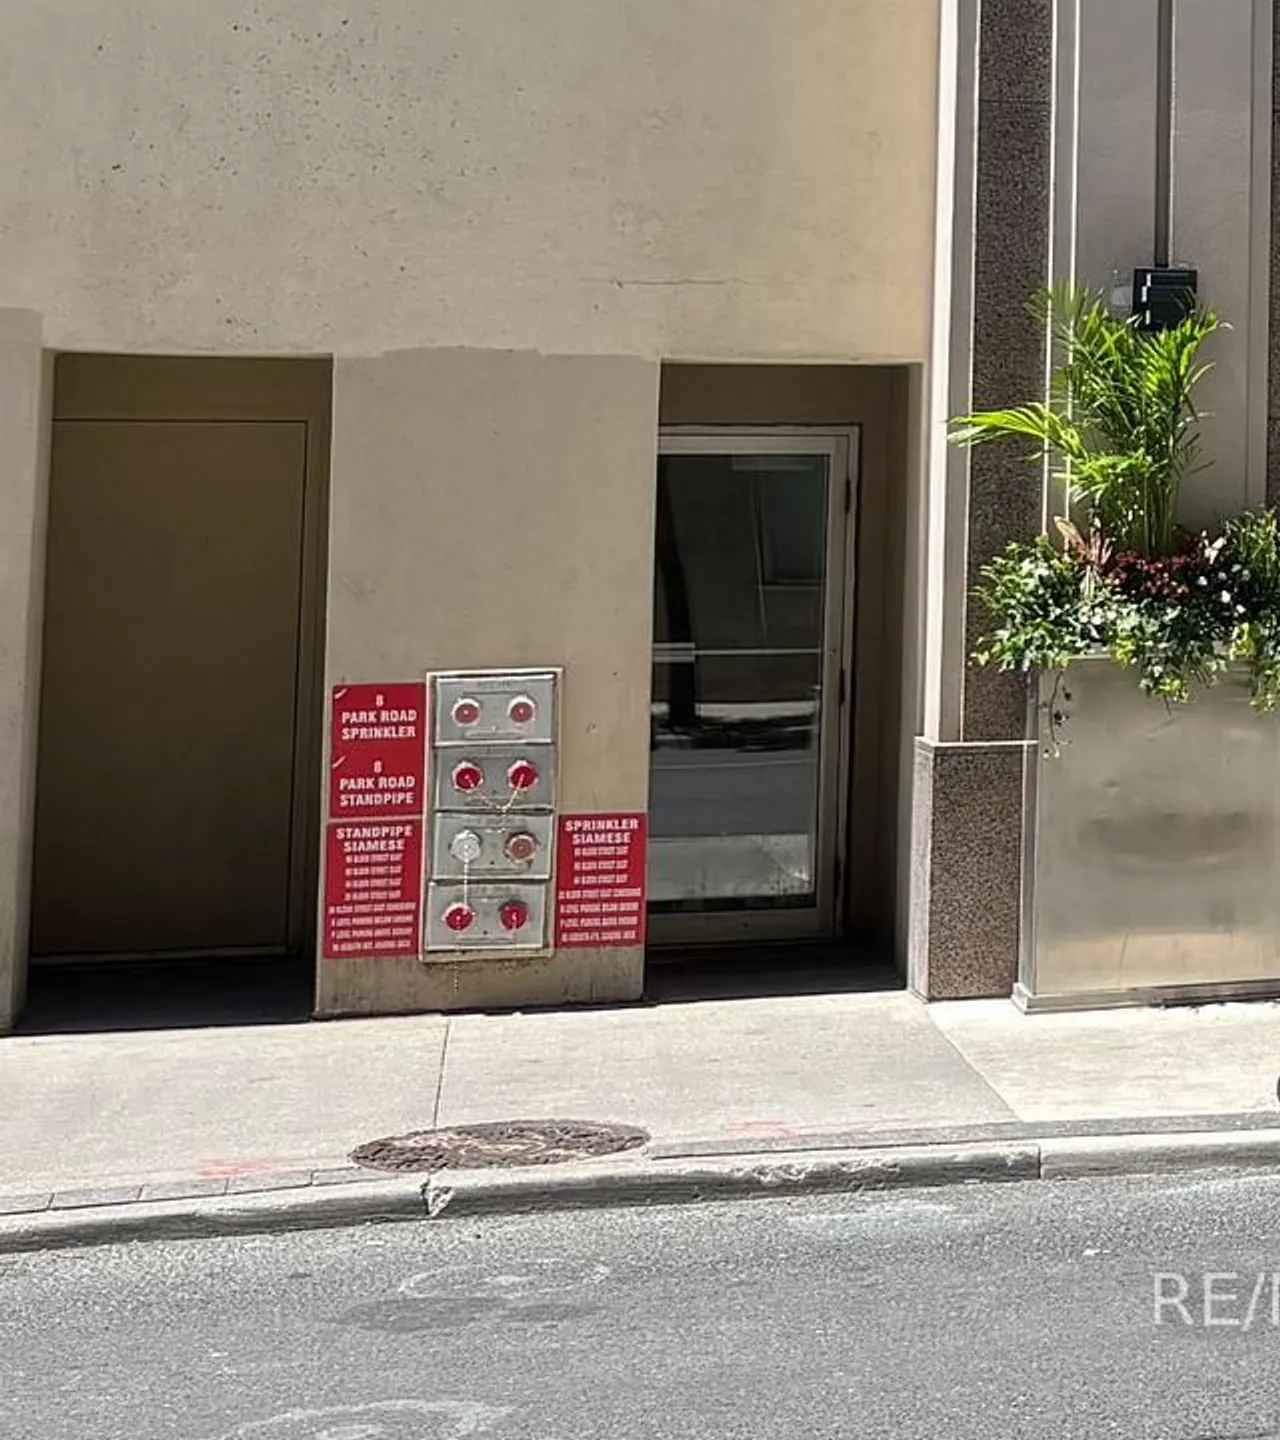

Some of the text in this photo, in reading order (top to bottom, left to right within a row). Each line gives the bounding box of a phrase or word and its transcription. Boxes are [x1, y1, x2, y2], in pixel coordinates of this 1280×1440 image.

[376, 694, 384, 707] 8
[342, 709, 417, 724] PARK ROAD
[341, 725, 417, 740] SPRINKLER
[339, 775, 416, 791] PARK ROAD
[339, 792, 415, 808] STANDPIPE
[336, 825, 413, 840] STANDPIPE
[565, 818, 640, 832] SPRINKLER
[572, 831, 632, 846] SIAMESE
[343, 839, 405, 854] SIAMESE
